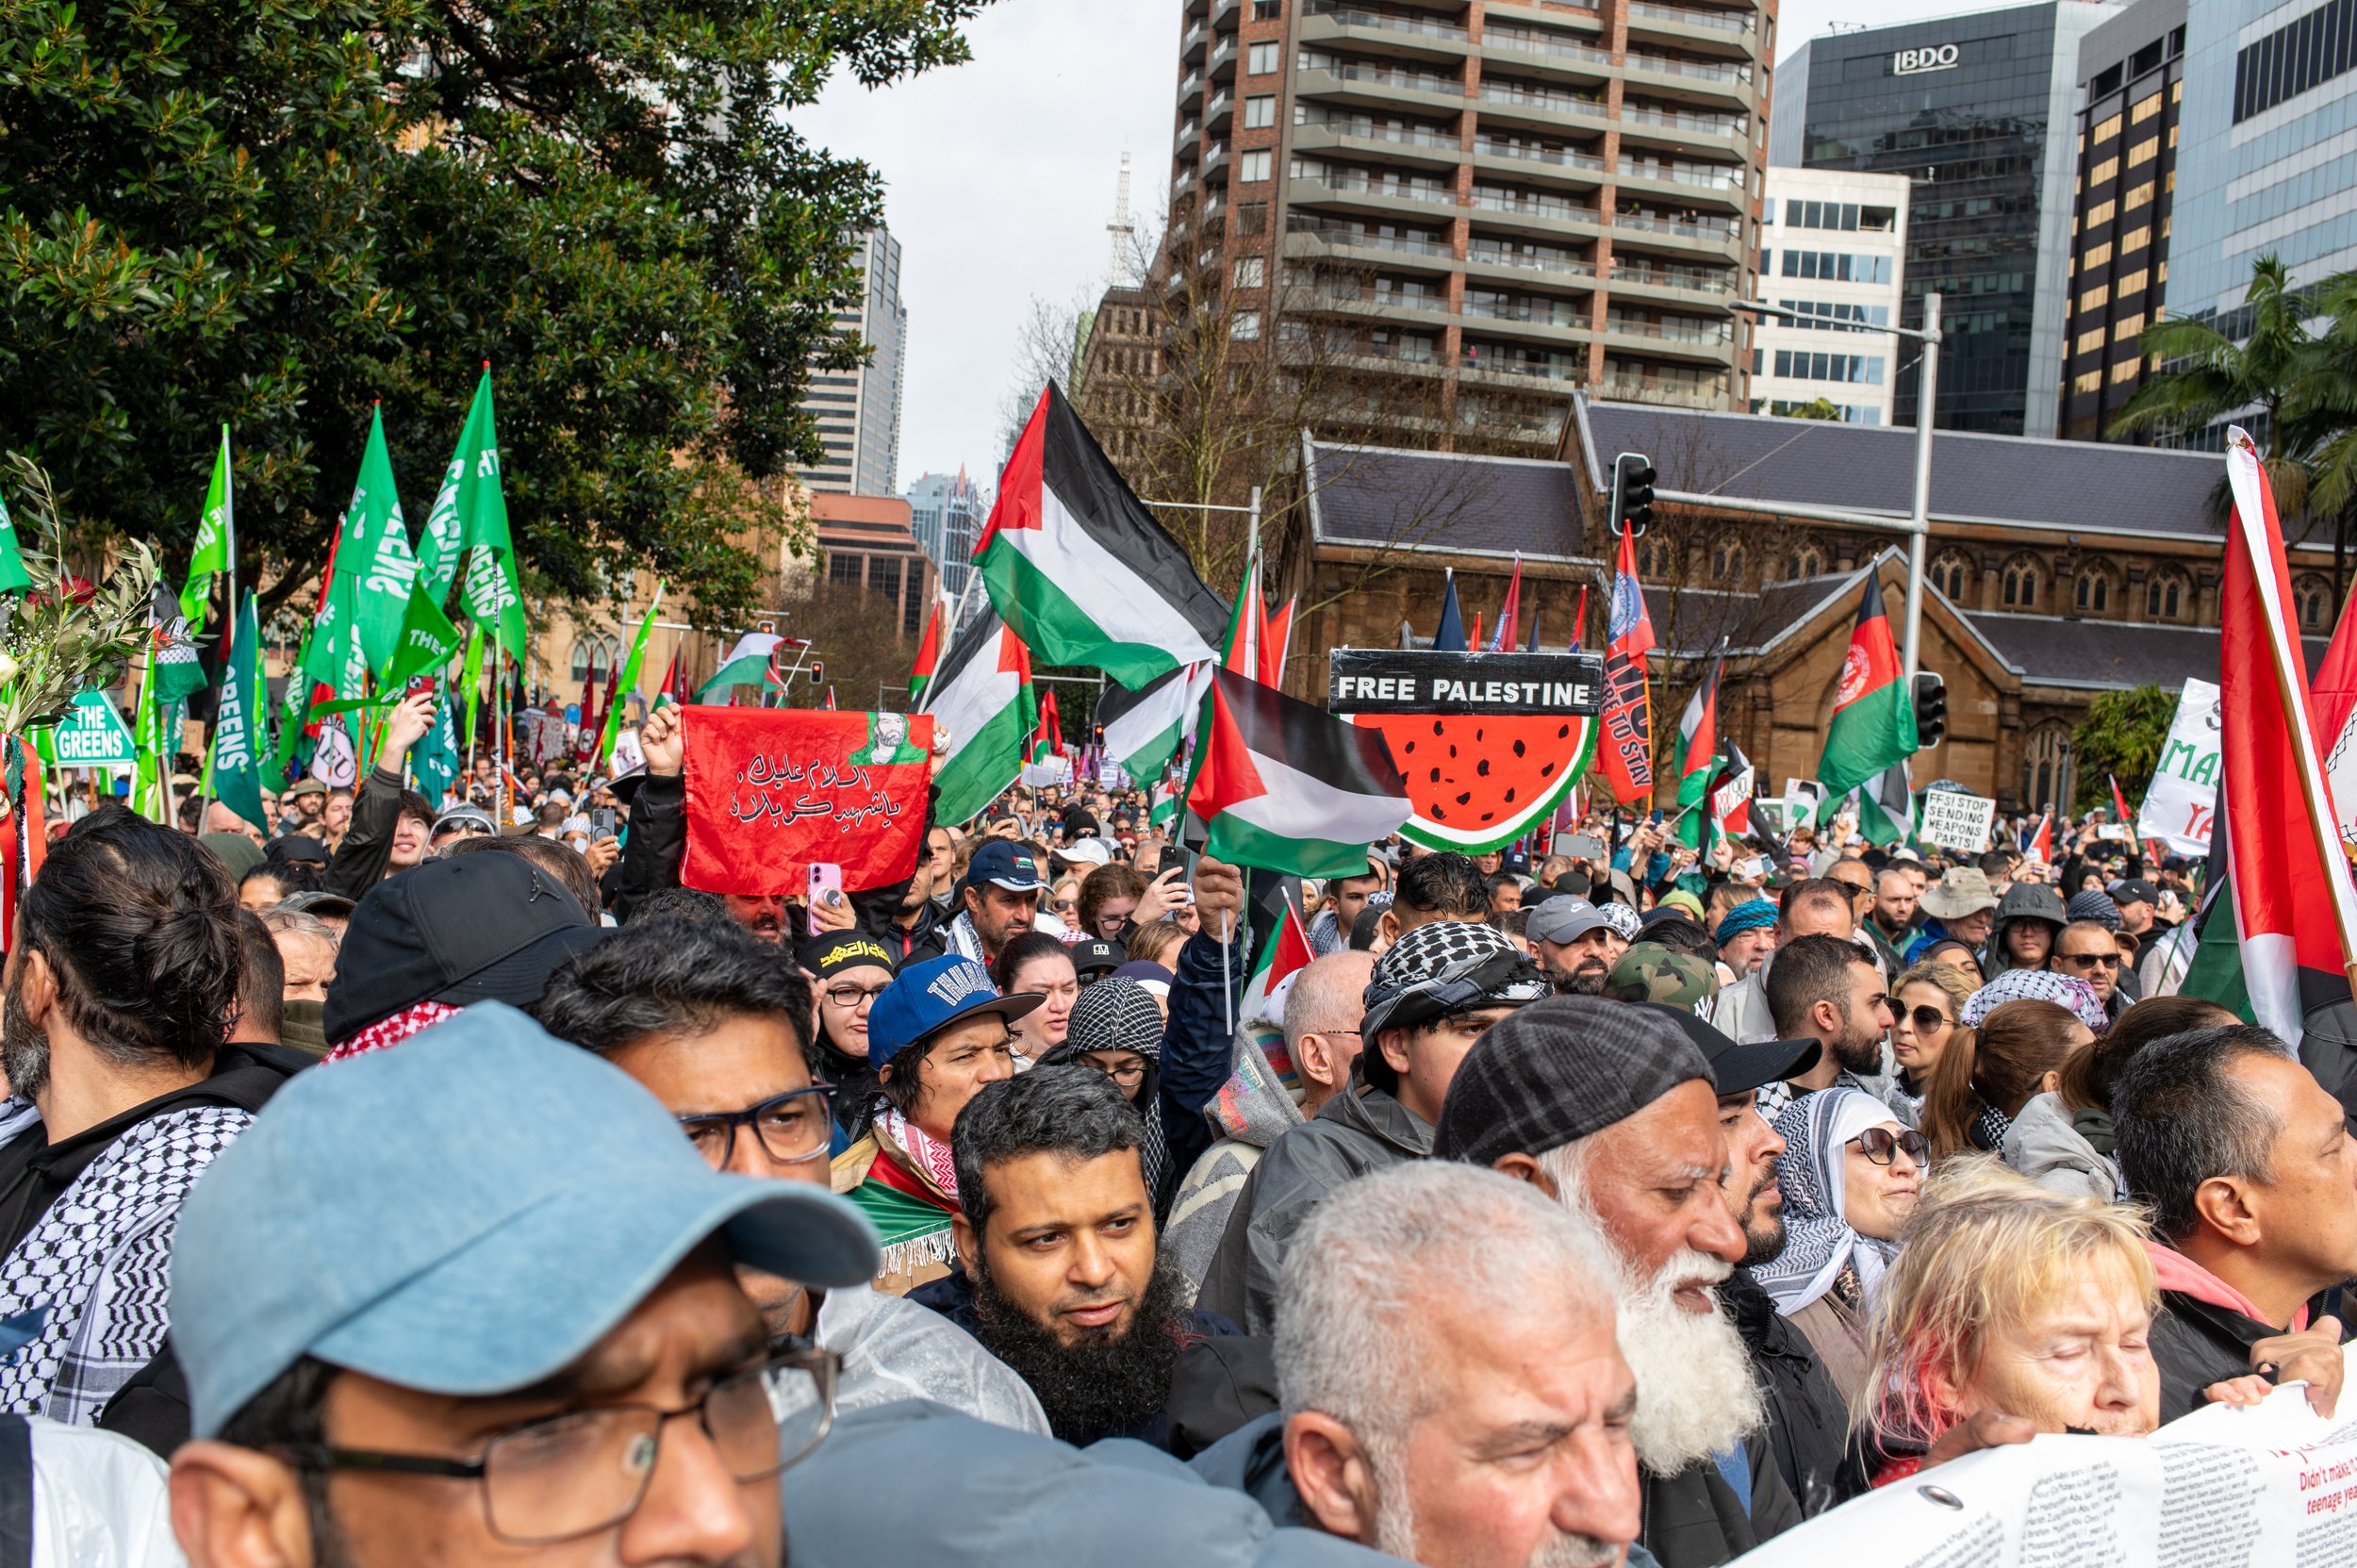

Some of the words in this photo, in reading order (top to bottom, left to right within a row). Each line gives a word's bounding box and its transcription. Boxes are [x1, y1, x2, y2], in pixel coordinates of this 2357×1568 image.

[1901, 43, 1959, 71] BDO
[409, 629, 440, 655] THE
[1338, 676, 1416, 701] FREE
[1432, 679, 1590, 706] PALESTINE
[76, 705, 107, 729] THE
[58, 730, 124, 758] GREENS
[1607, 711, 1633, 741] TO
[1620, 740, 1653, 788] STAY
[2159, 738, 2219, 788] MA
[1928, 806, 1985, 824] SENDING
[1929, 793, 1955, 807] FFS!
[1957, 798, 1988, 812] STOP
[1928, 818, 1982, 837] WEAPONS
[1935, 832, 1976, 849] PARTS!
[2299, 1465, 2328, 1492] Didn't
[2329, 1460, 2351, 1482] make
[2307, 1492, 2342, 1515] teenage
[2344, 1485, 2357, 1509] yea
